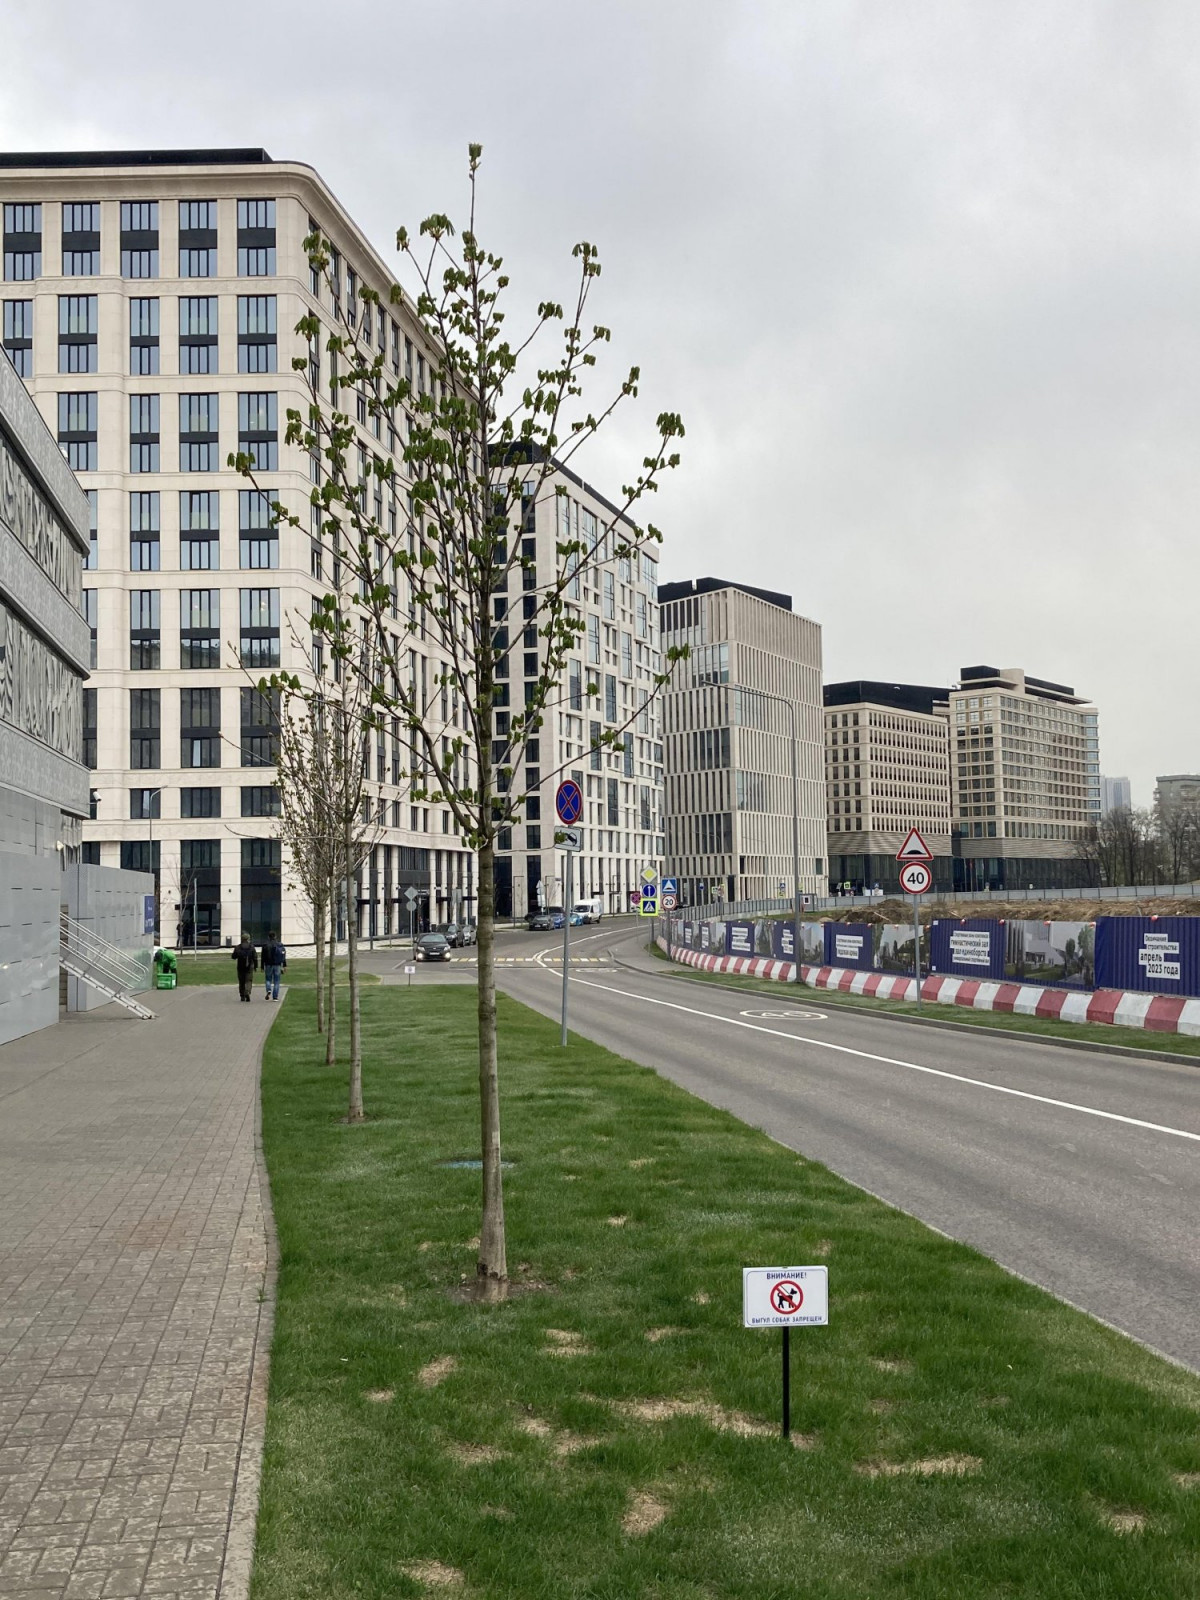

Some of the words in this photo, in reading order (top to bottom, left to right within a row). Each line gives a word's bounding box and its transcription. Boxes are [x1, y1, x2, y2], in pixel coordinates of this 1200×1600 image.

[907, 872, 925, 885] 40
[665, 898, 674, 906] 20
[1140, 953, 1163, 963] апрель
[1148, 963, 1163, 974] 2023
[1163, 966, 1179, 976] года
[766, 1272, 807, 1280] ВНИМАНИЕ!
